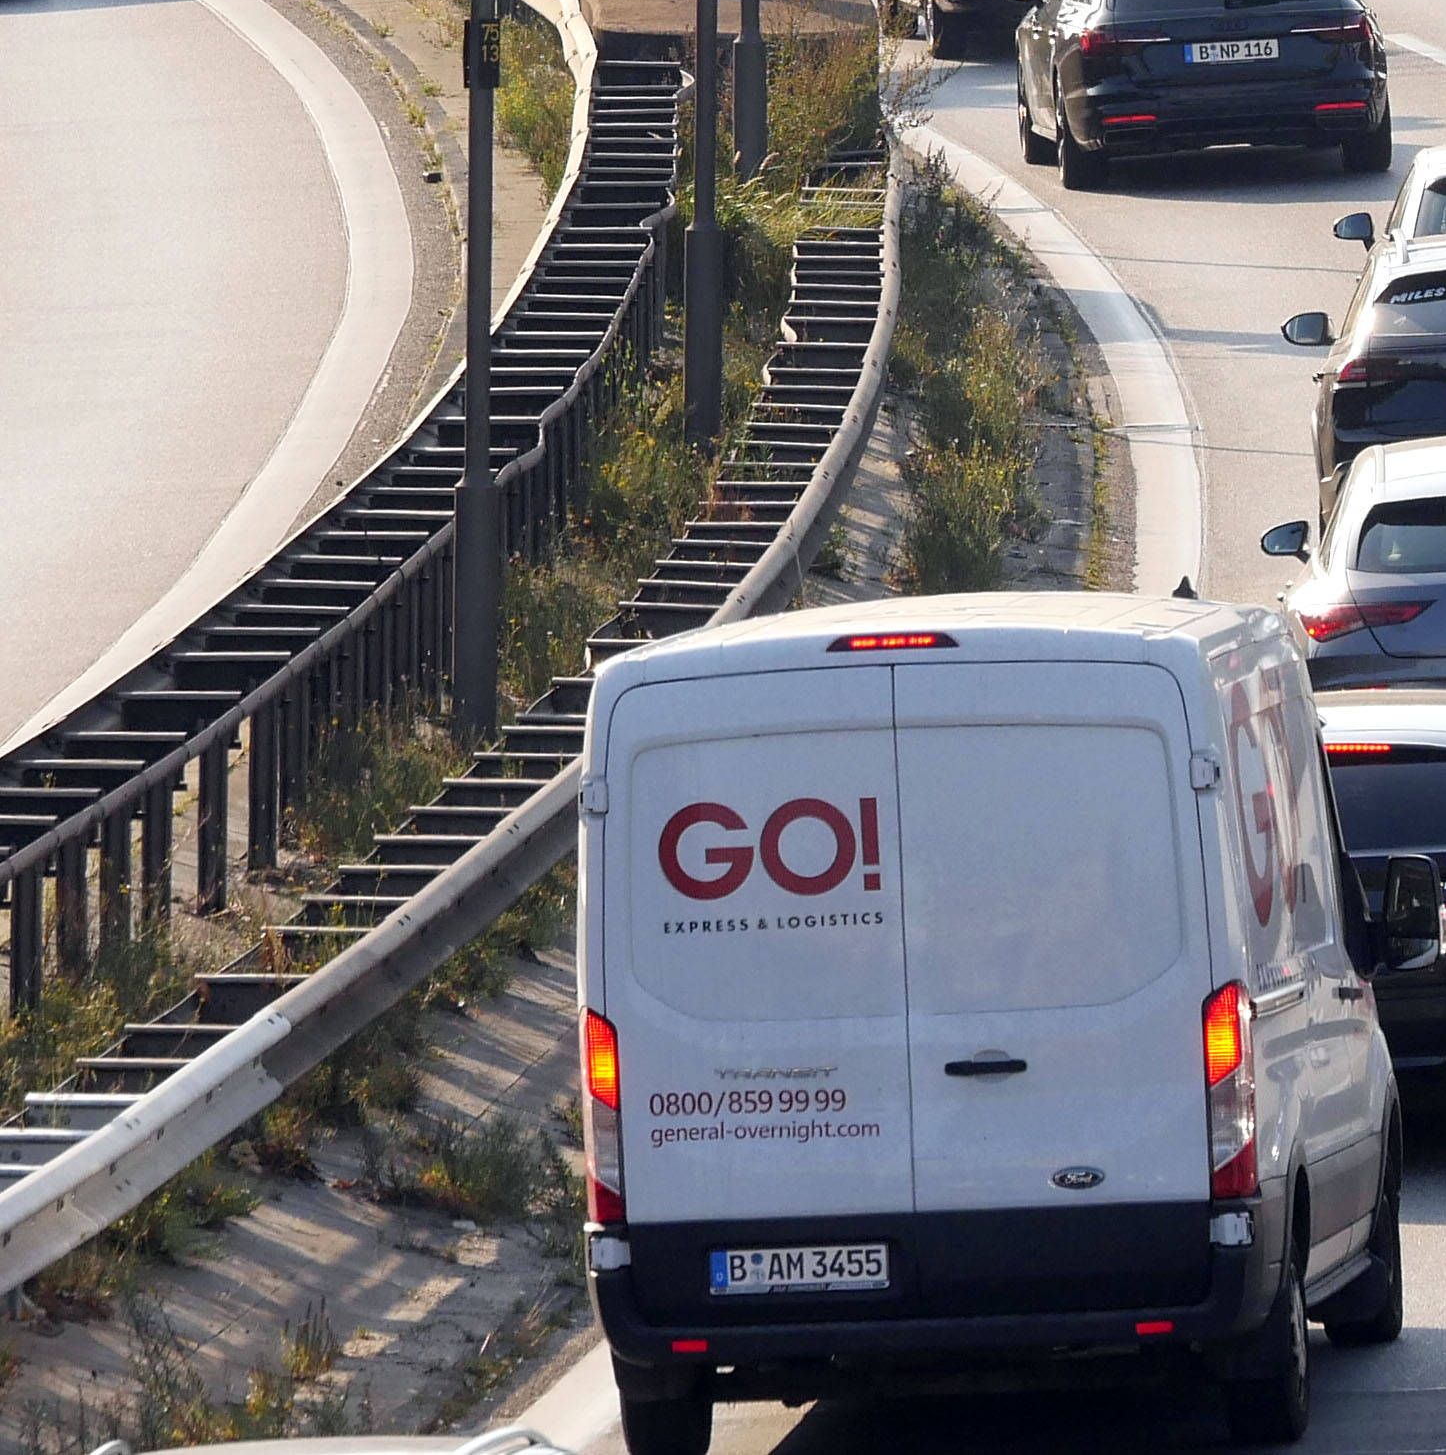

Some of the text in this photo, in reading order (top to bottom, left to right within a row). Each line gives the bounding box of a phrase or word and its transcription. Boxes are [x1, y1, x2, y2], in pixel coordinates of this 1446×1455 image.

[1199, 41, 1273, 60] B NP 116
[1390, 286, 1446, 304] MILES
[658, 797, 881, 901] GO!
[663, 912, 884, 934] EXPRESS & LOGISTICS
[714, 1066, 838, 1080] TRANSIT
[650, 1089, 773, 1118] 0800/859
[650, 1119, 881, 1148] general-overnight.com
[729, 1249, 883, 1282] B AM 3455
